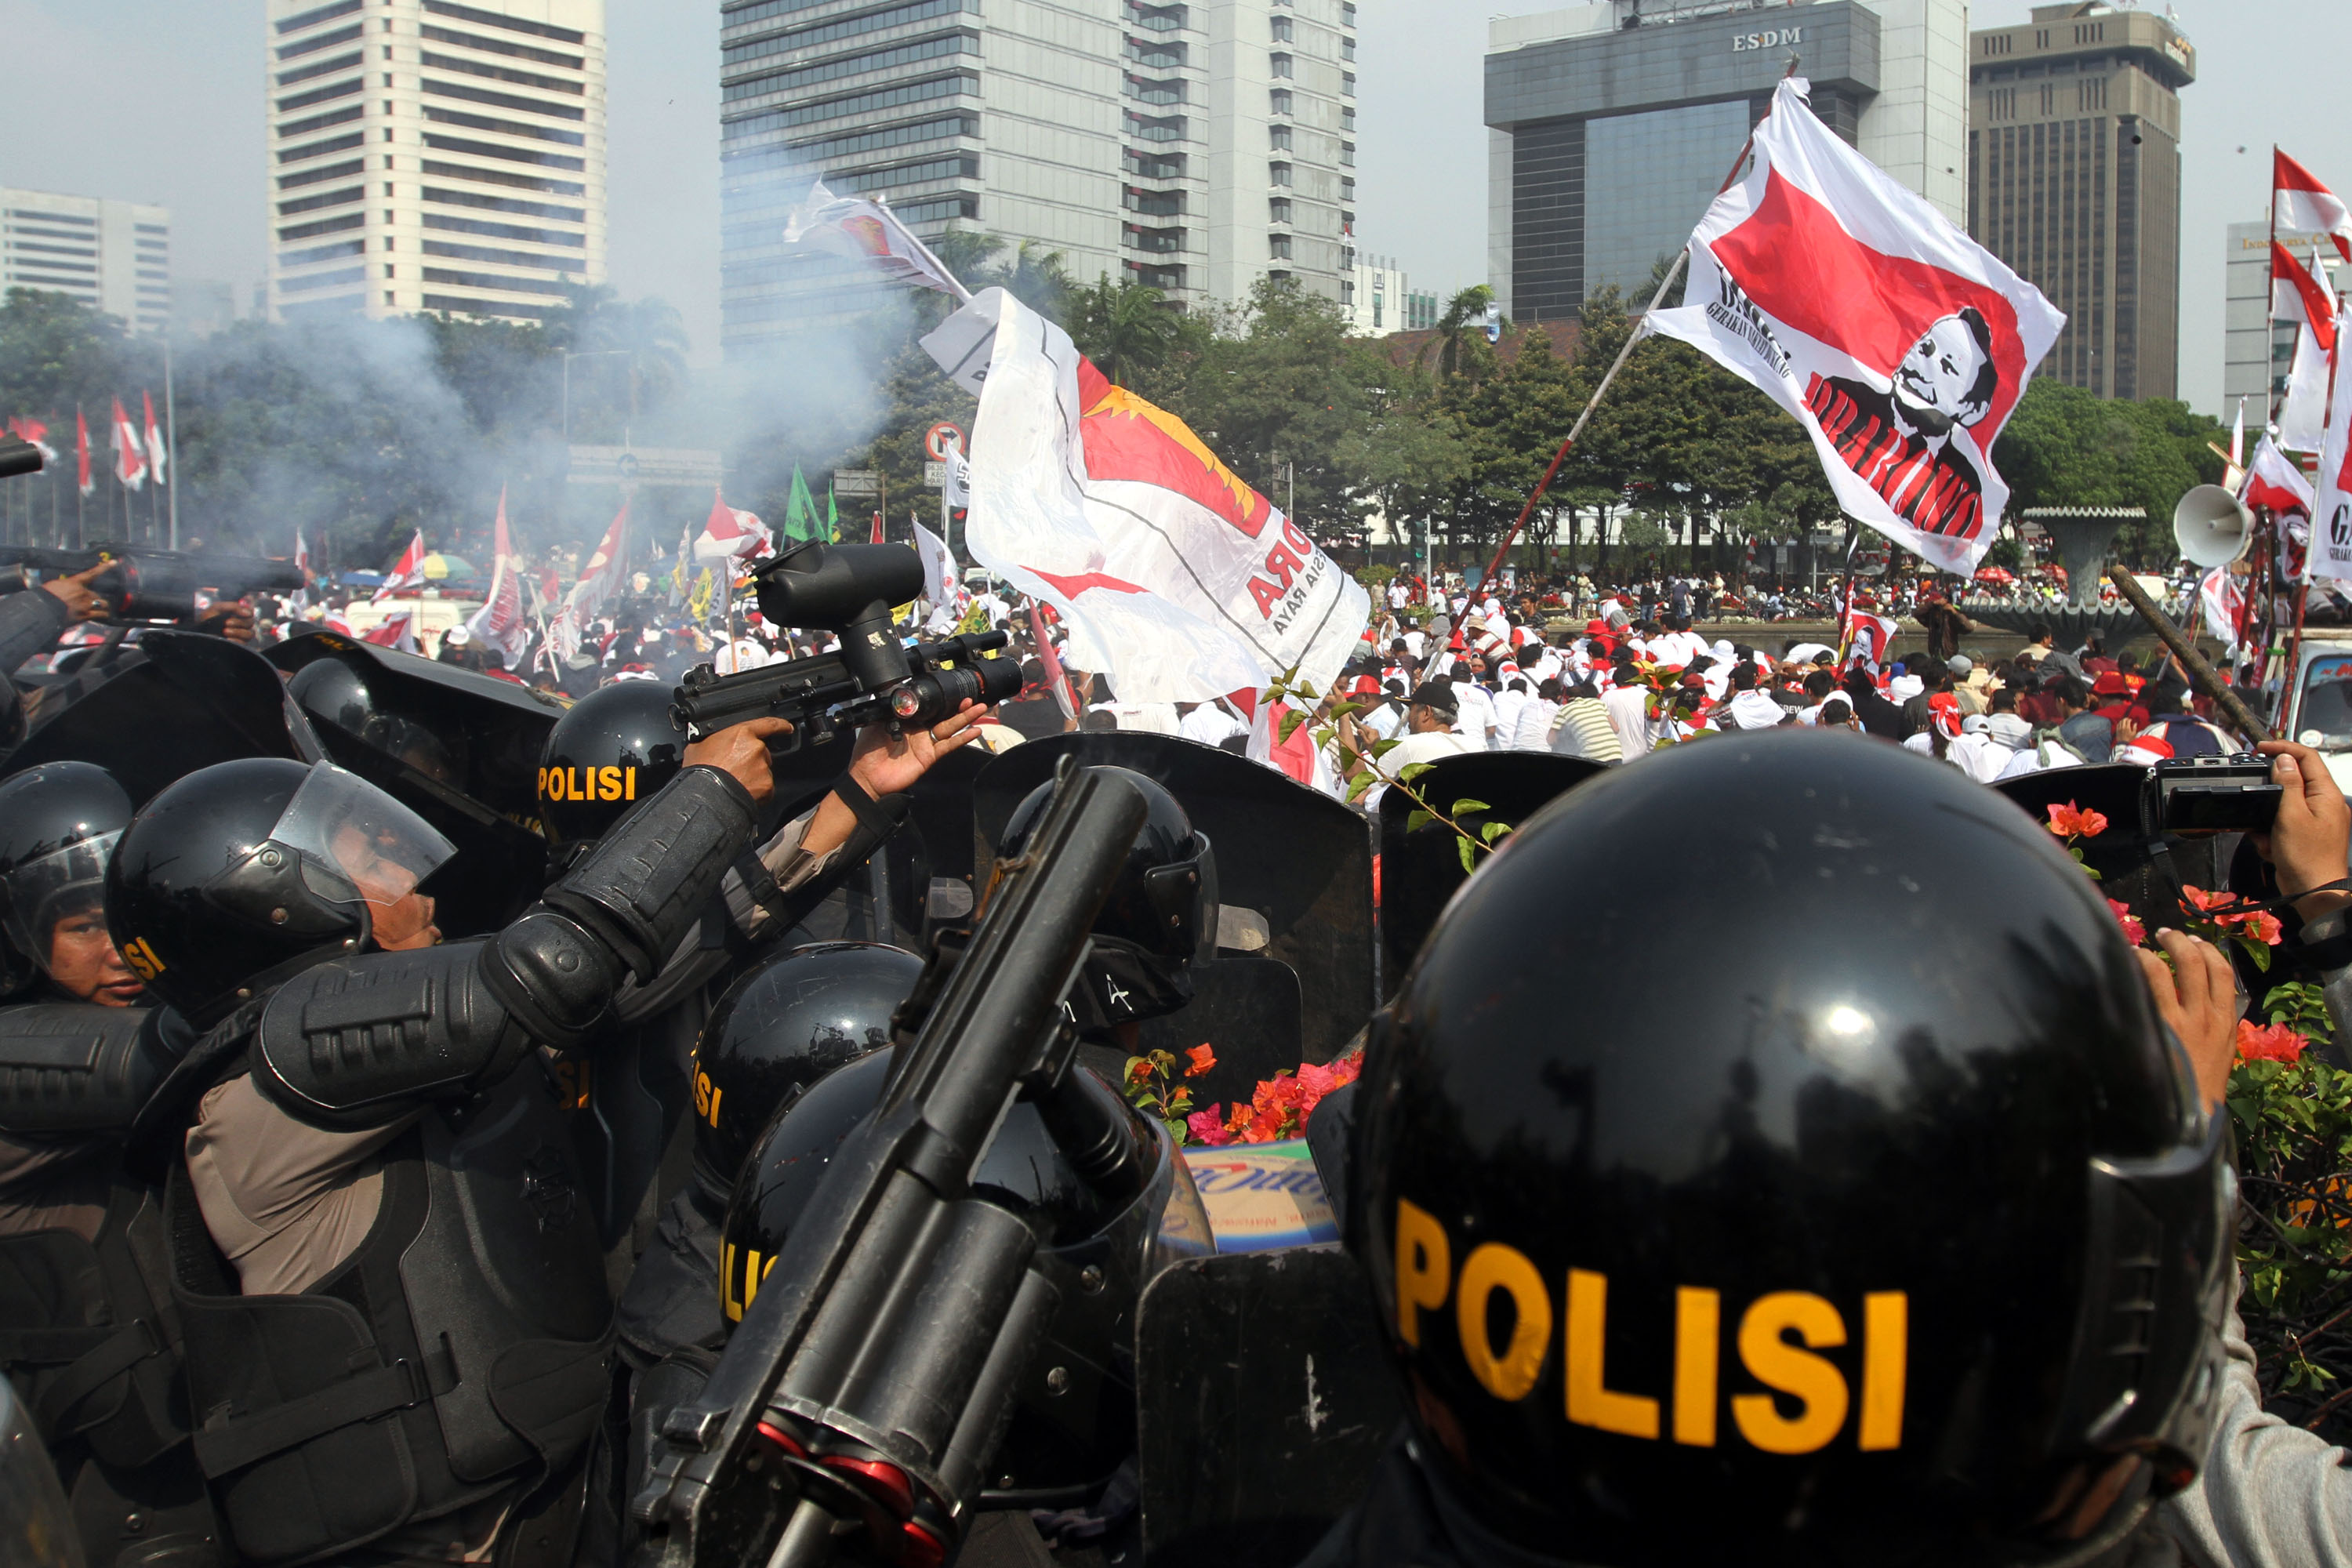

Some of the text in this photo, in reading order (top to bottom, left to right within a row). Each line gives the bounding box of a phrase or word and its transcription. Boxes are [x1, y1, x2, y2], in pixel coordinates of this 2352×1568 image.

[1733, 27, 1802, 52] ESDM
[1779, 703, 1804, 714] REW
[538, 765, 636, 801] POLISI
[1396, 1196, 1907, 1455] POLISI
